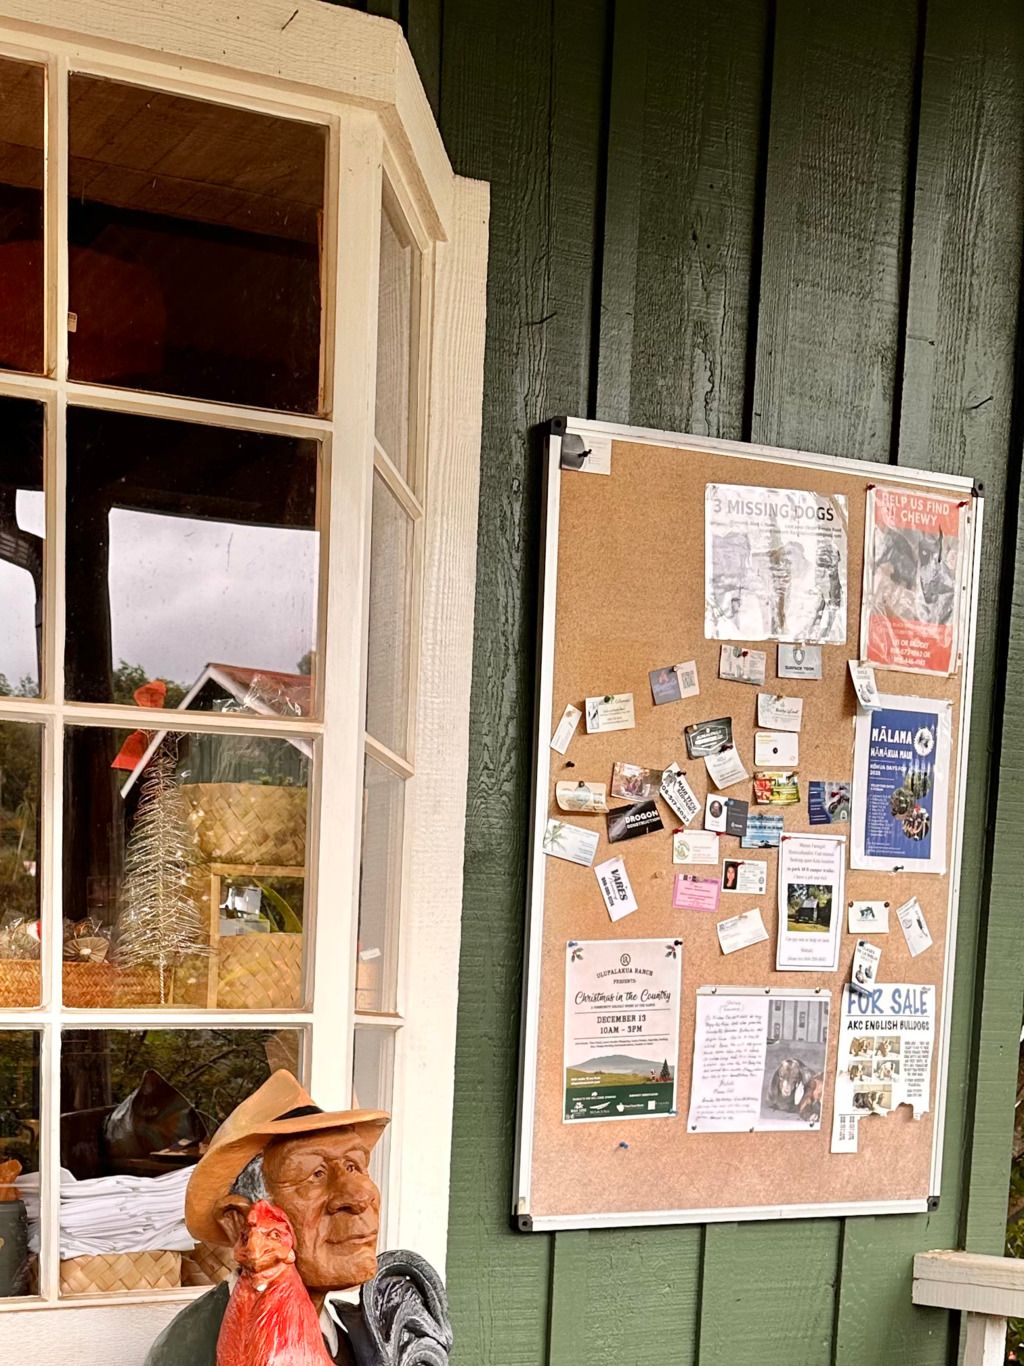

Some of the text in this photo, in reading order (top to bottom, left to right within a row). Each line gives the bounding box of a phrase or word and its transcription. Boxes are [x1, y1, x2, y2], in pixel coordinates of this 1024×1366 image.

[713, 498, 834, 522] 3 MISSING DOGS
[882, 493, 950, 516] HELP US FIND
[901, 510, 938, 526] CHEWY
[625, 810, 658, 823] DROGON
[596, 968, 654, 978] ULUPALAKUA RANCH
[574, 989, 671, 1005] Christmas in the Country
[847, 987, 928, 1015] FOR SALE
[597, 1014, 647, 1024] DECEMBER 13
[847, 1020, 930, 1031] AKC ENGLISH BULLDOGS
[627, 1025, 643, 1033] 3PM
